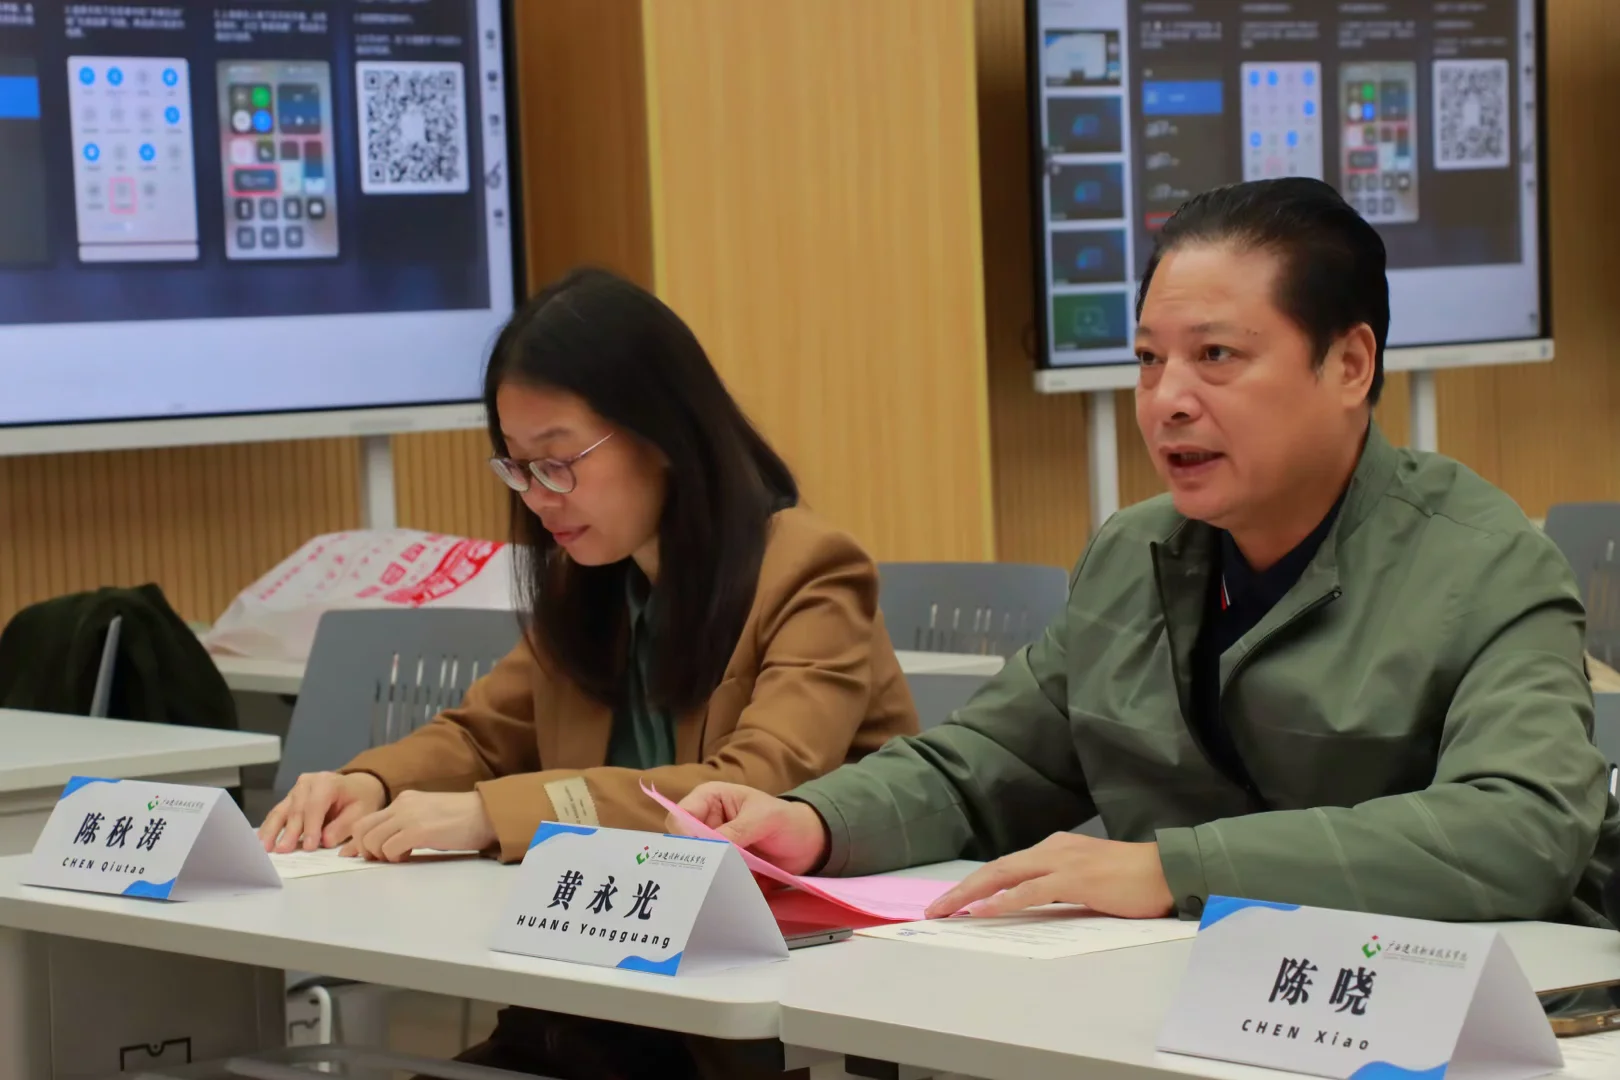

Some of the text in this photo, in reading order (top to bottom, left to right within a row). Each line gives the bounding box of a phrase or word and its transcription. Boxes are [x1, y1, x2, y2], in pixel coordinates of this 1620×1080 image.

[73, 812, 167, 852] 陈秋涛
[62, 857, 145, 875] CHEN Qiutao
[547, 869, 661, 921] 黄永光
[516, 914, 671, 949] HUANG Yongguang
[1268, 956, 1377, 1017] 陈晓
[1241, 1019, 1370, 1051] CHEN Xiao
